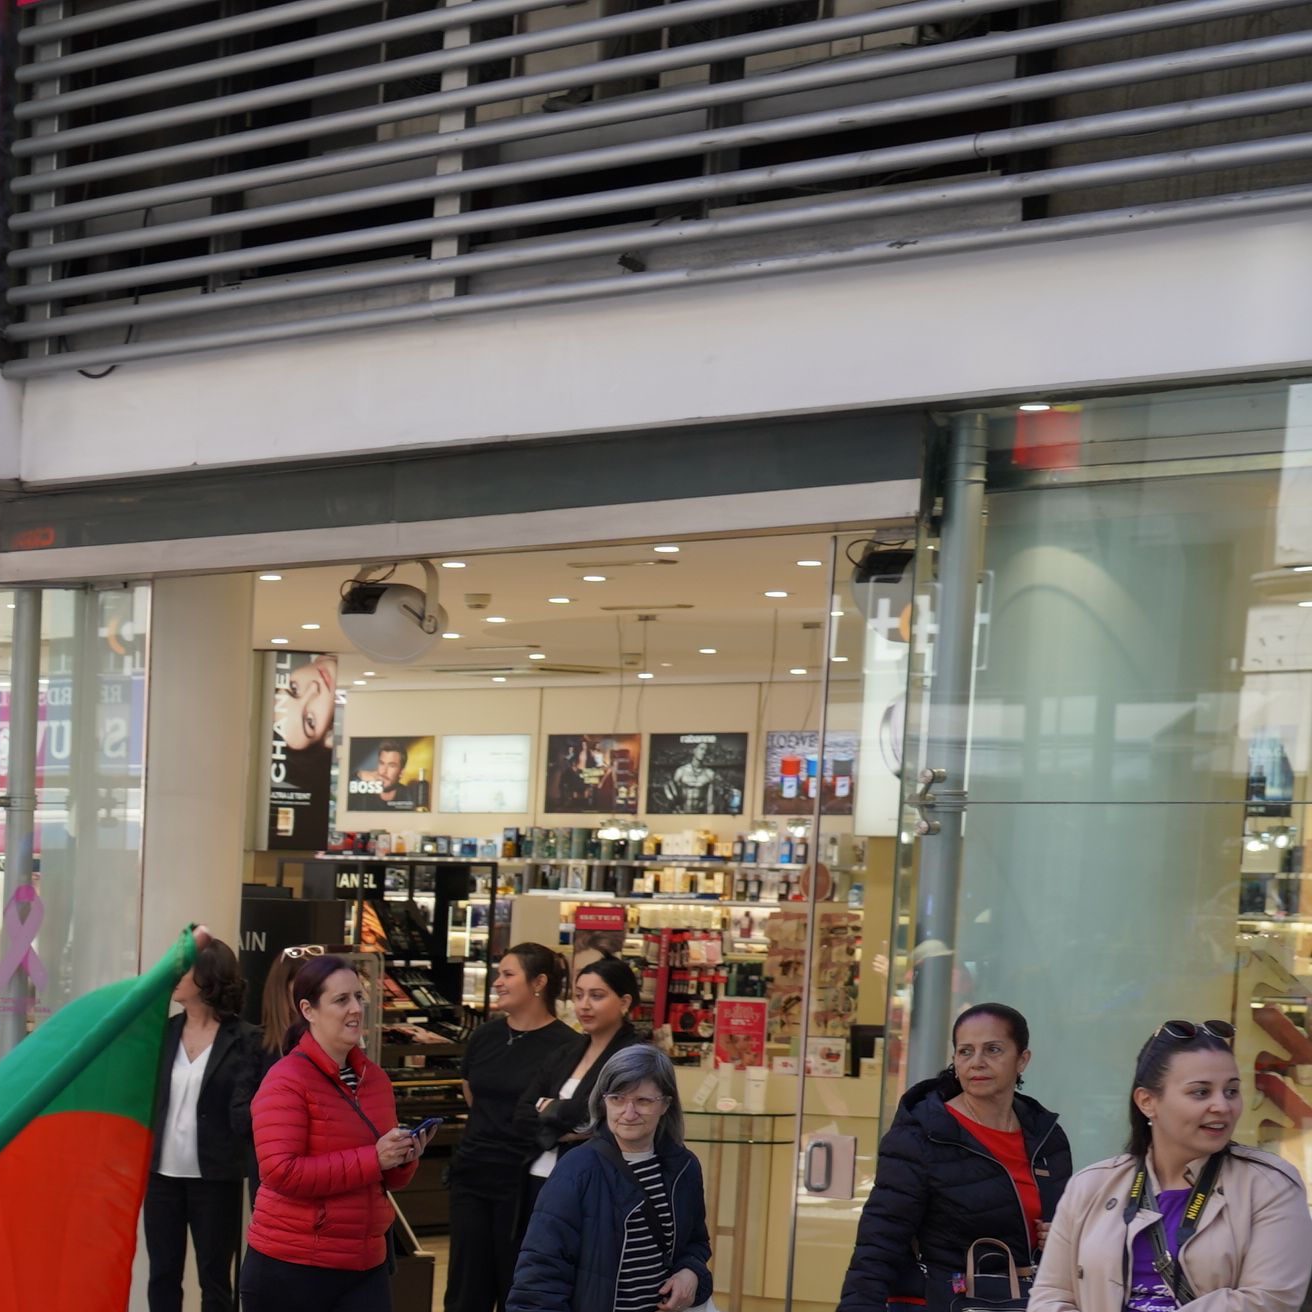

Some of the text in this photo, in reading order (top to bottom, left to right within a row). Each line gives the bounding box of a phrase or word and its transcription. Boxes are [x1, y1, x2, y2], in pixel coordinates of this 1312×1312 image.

[348, 780, 384, 795] BOSS
[1130, 1170, 1145, 1198] Nikon
[1185, 1192, 1207, 1221] Nikon
